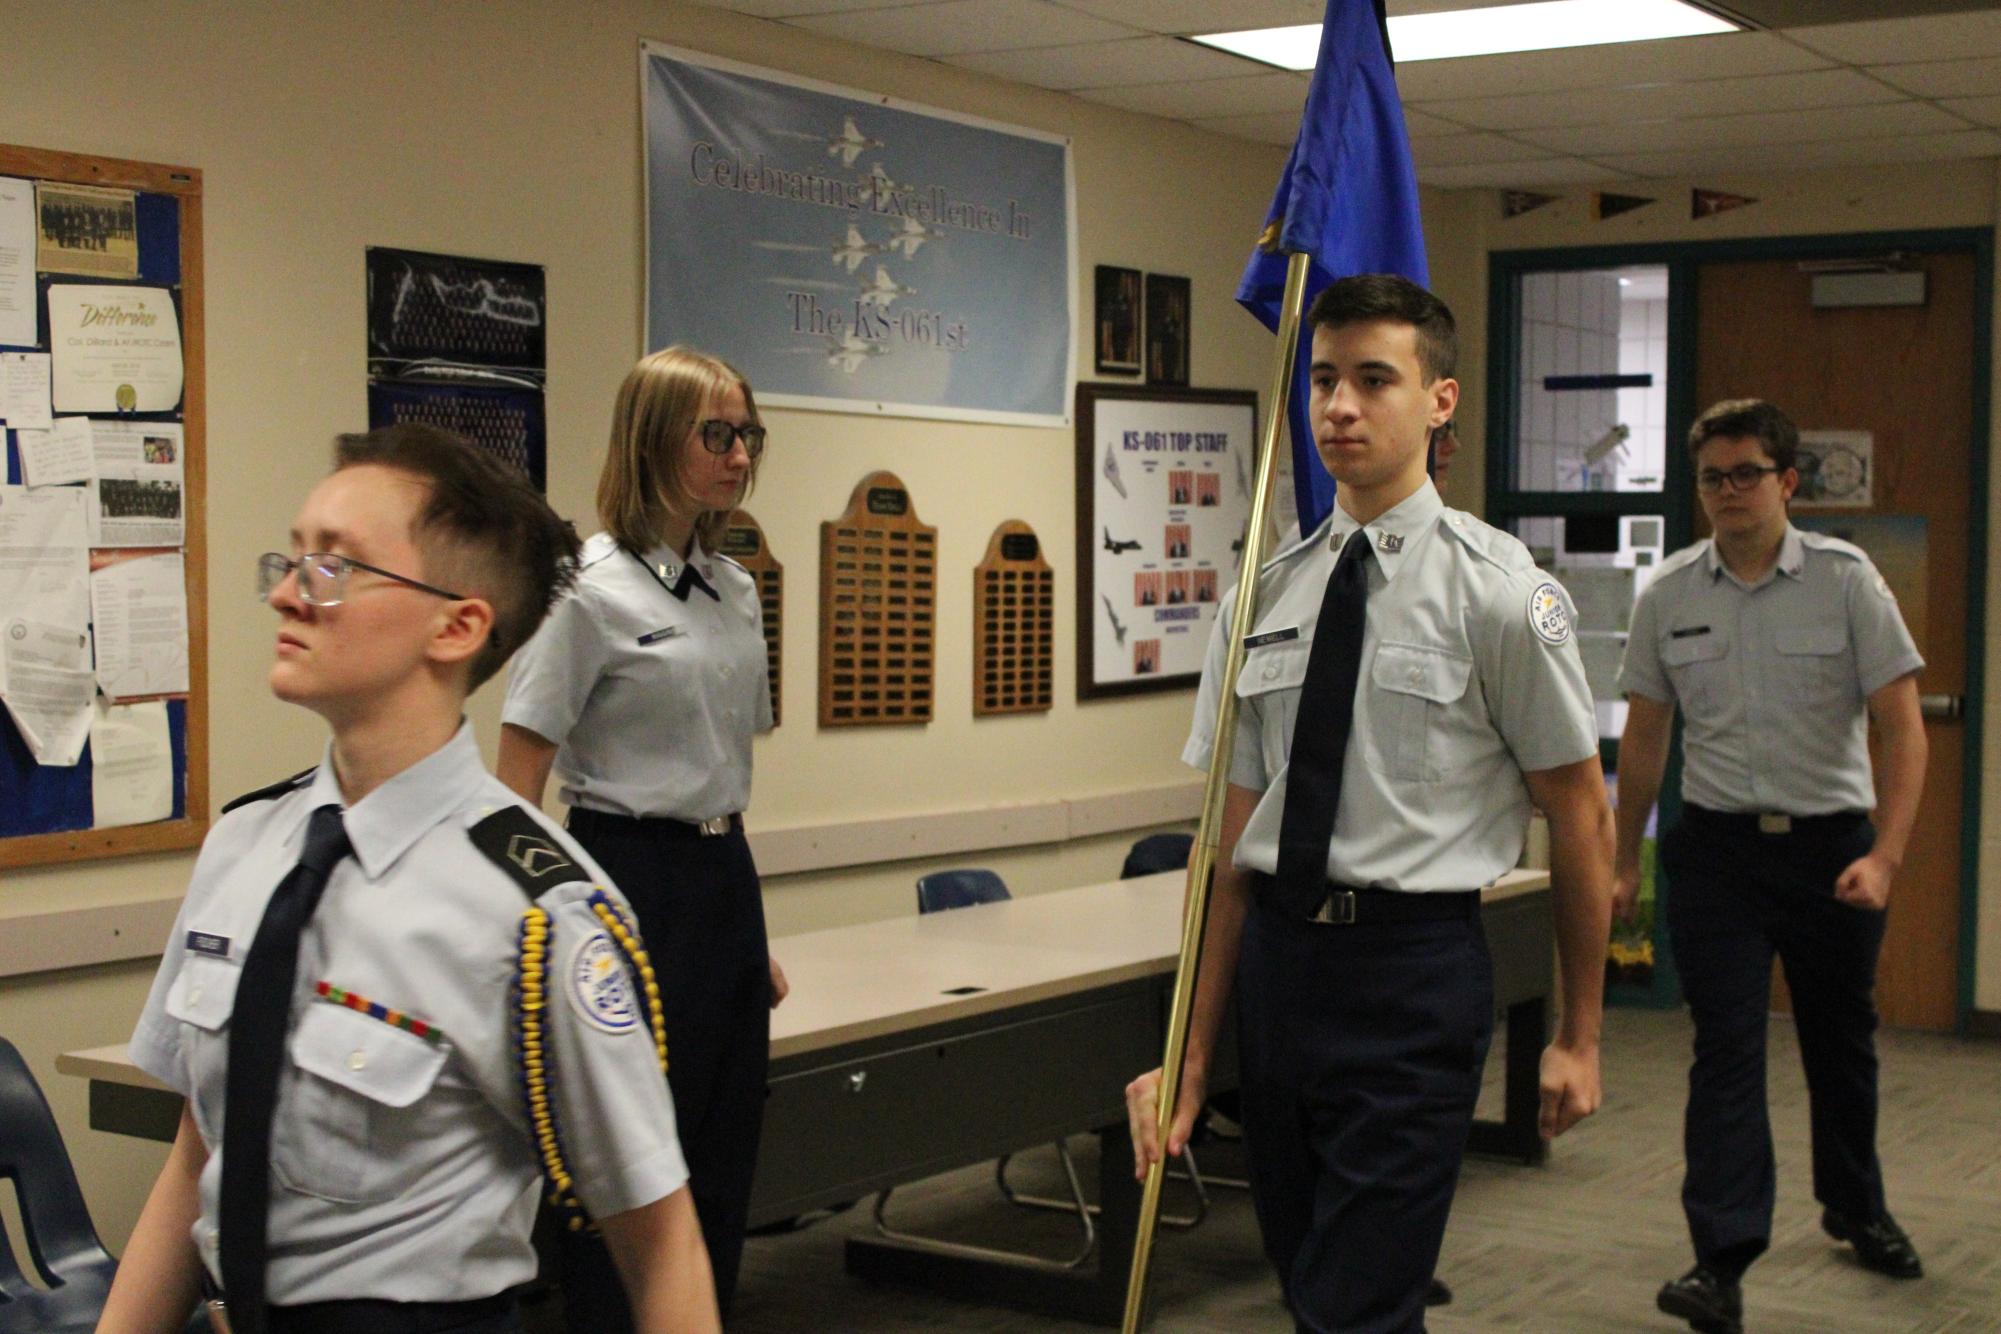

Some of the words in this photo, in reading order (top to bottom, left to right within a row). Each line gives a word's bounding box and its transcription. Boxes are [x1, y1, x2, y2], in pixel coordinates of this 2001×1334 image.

[690, 141, 862, 214] Celebrating
[870, 174, 1002, 231] Excellence
[1008, 199, 1032, 239] In
[787, 290, 842, 335] The
[852, 300, 970, 349] KS-061st
[1123, 431, 1167, 451] KS-061
[1169, 432, 1193, 452] TOP
[1195, 433, 1228, 452] STAFF
[1541, 610, 1566, 631] ROTC
